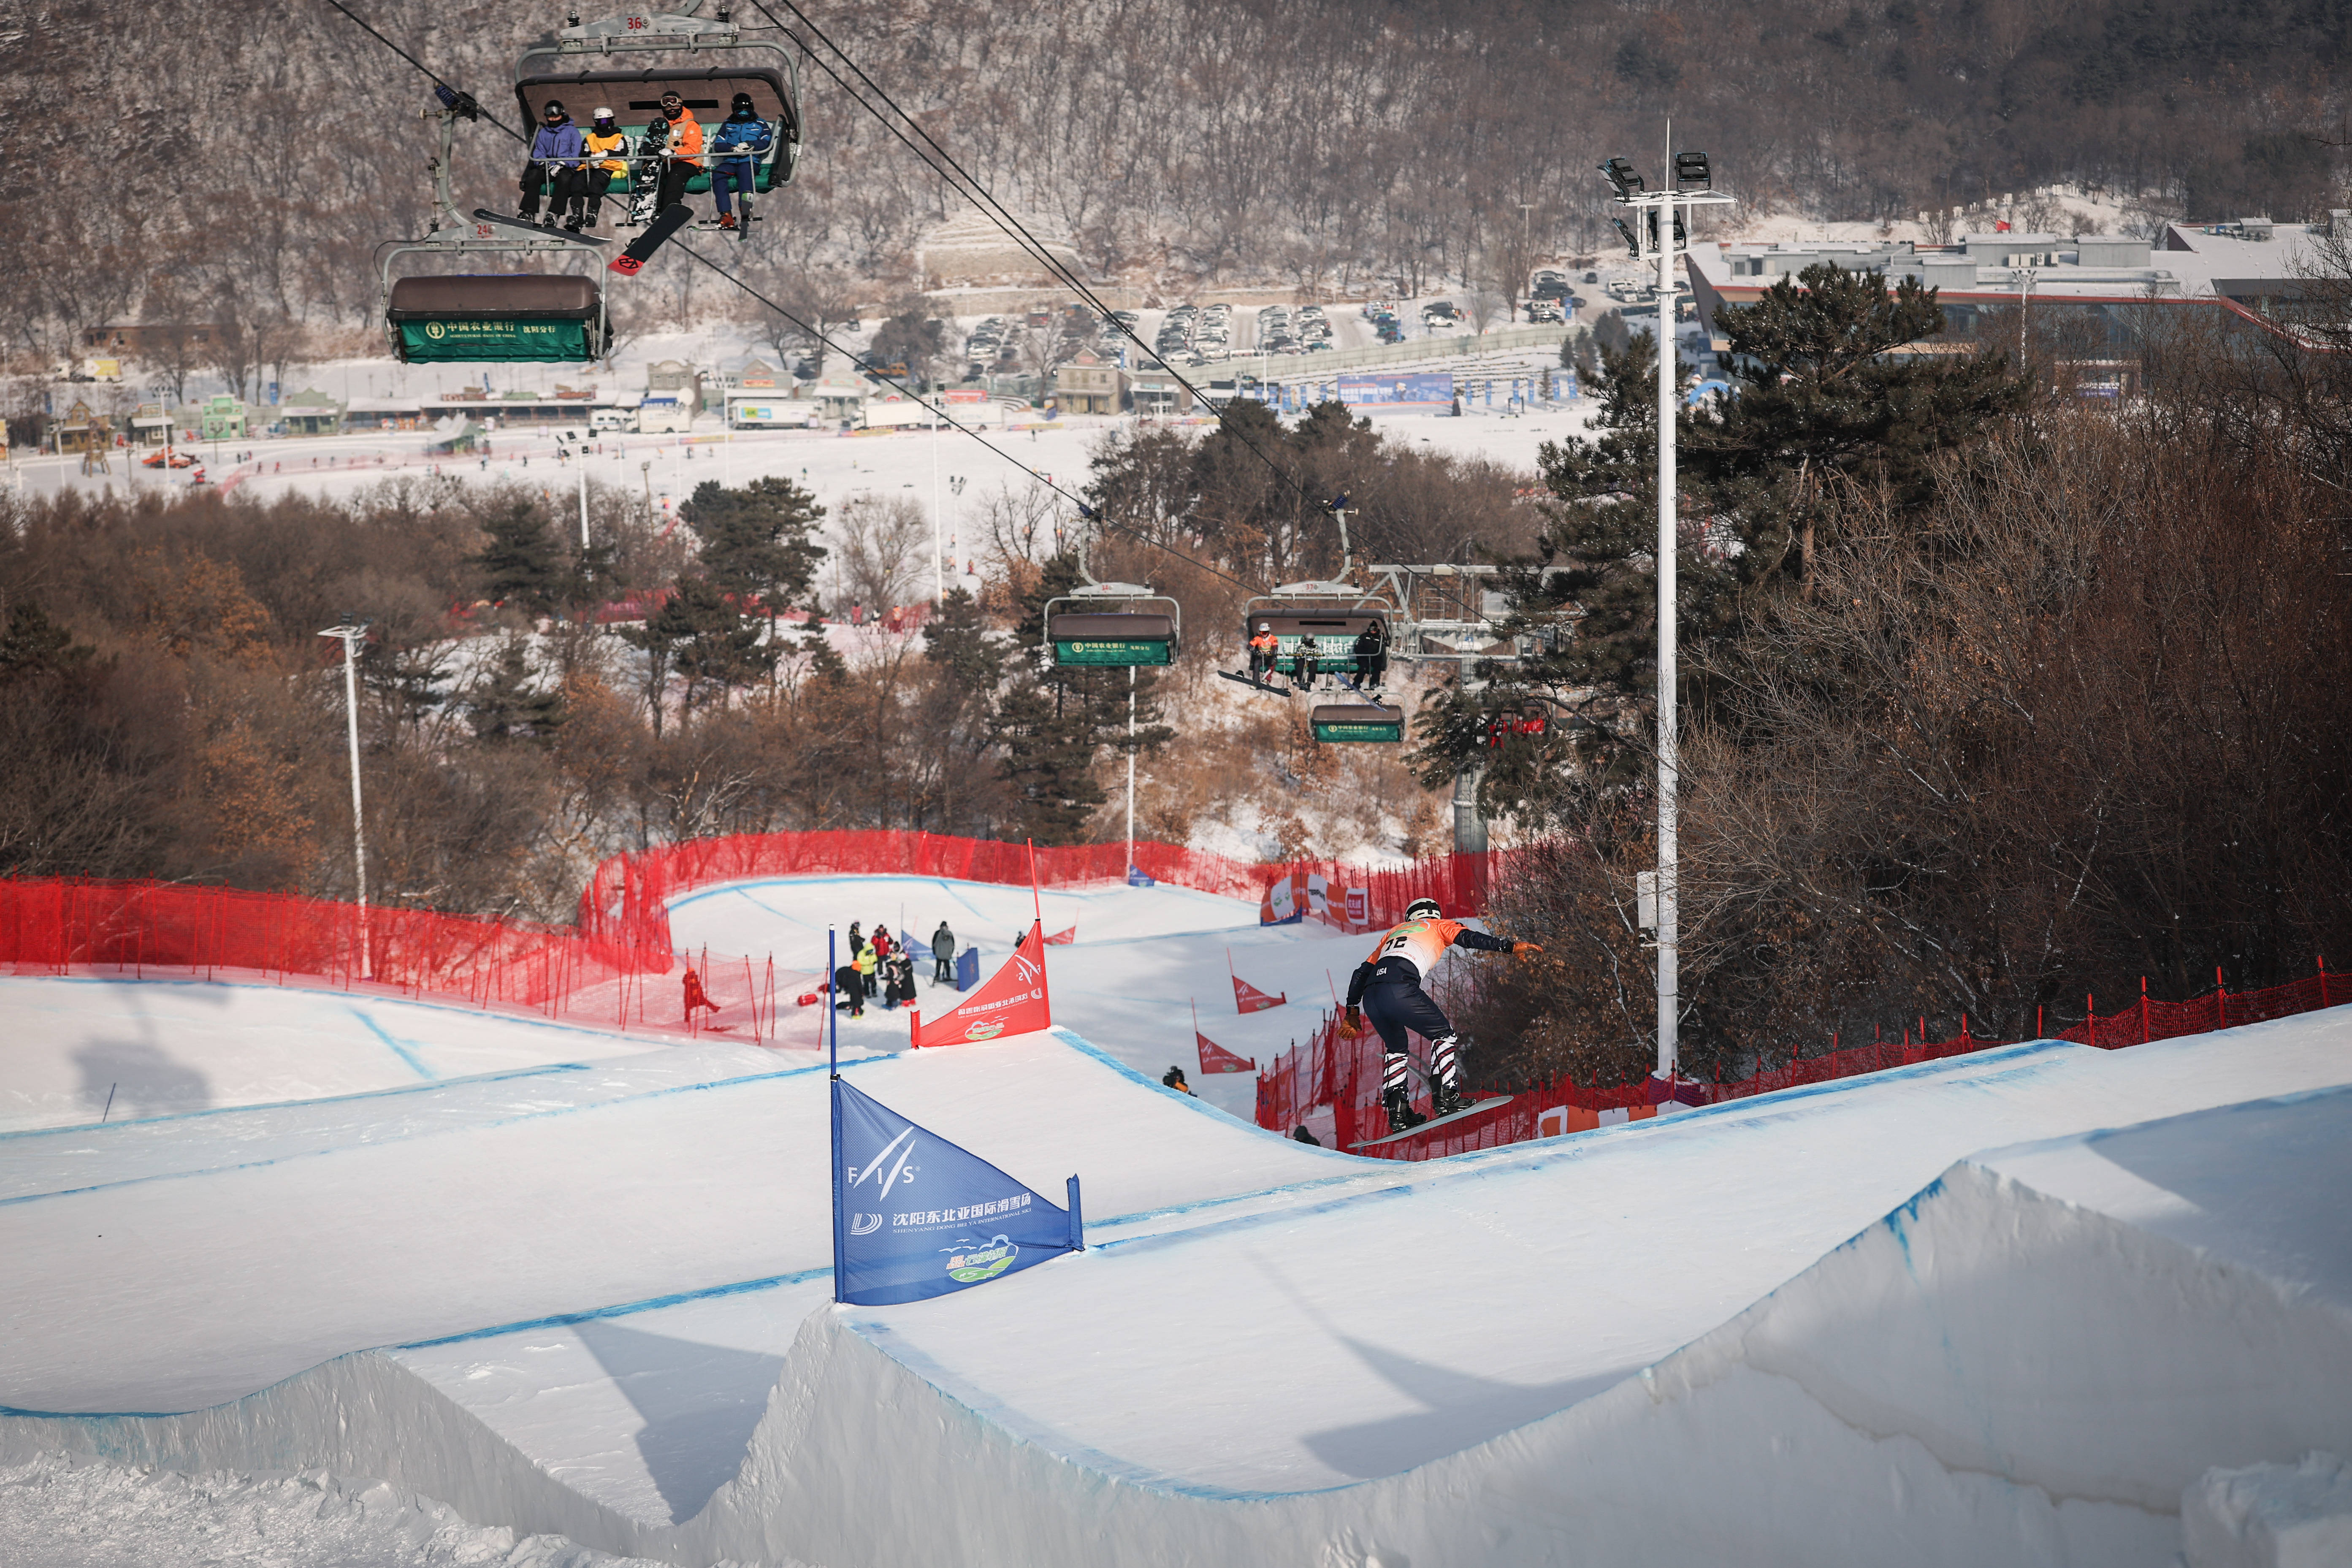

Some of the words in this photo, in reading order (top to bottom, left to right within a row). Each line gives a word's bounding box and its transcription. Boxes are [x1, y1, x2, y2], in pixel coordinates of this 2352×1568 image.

[627, 17, 642, 30] 36
[447, 321, 515, 332] 中国农业银行
[523, 325, 555, 333] 沈阳分行
[1376, 967, 1387, 976] USA
[892, 1192, 1031, 1226] 沈阳东北亚国际滑雪场
[978, 1212, 1020, 1224] INTERNATIONAL
